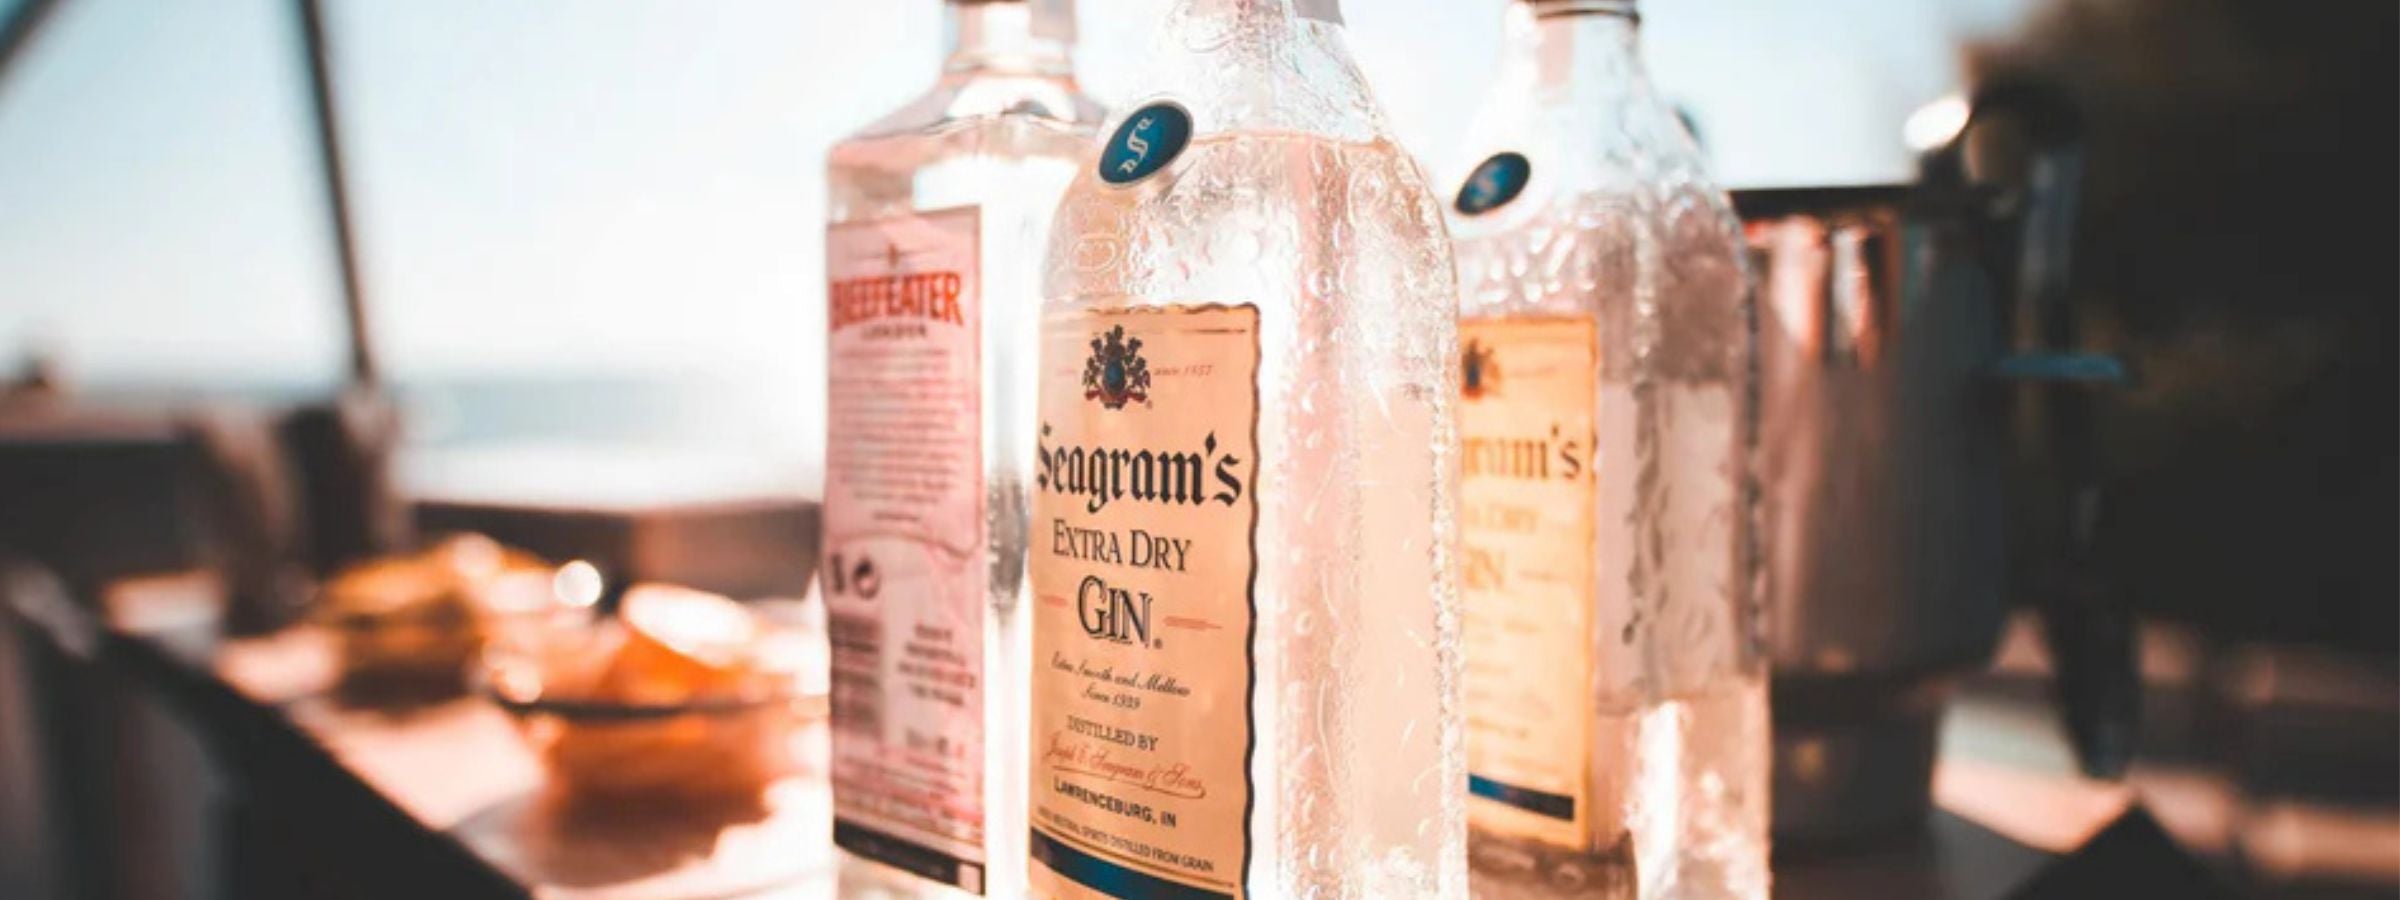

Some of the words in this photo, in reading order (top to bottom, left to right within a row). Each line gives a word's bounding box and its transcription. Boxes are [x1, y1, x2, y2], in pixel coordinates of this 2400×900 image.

[831, 271, 964, 333] BEEFEATER
[1037, 421, 1243, 513] Seagram's
[1129, 528, 1192, 571] DRY
[1077, 575, 1153, 647] GIN
[1114, 672, 1139, 688] and
[1139, 672, 1191, 697] Mellow
[1067, 715, 1136, 747] DISTILLED
[1137, 732, 1159, 751] BY
[1160, 811, 1177, 828] IN
[1151, 847, 1180, 865] FROM
[1181, 854, 1214, 873] GRAIN
